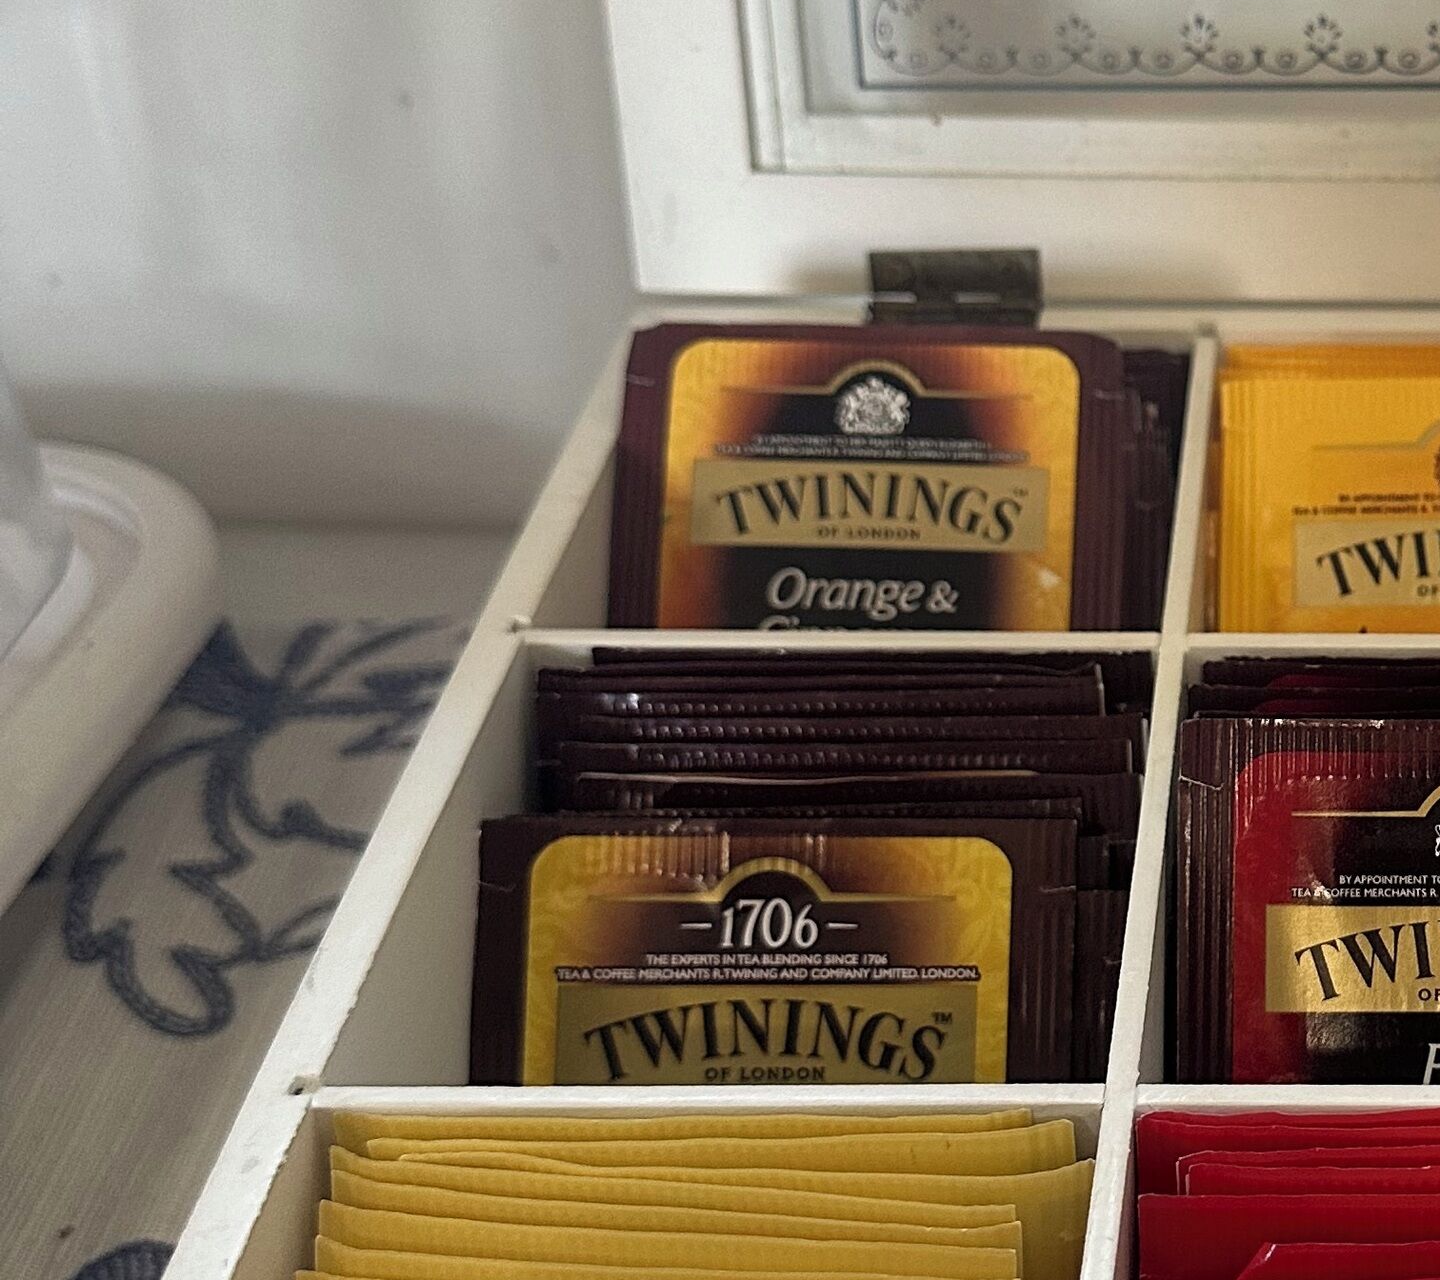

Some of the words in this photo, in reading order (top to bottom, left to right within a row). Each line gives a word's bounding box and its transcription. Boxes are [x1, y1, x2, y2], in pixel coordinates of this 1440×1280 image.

[717, 470, 1023, 545] TWININGS
[817, 527, 838, 539] OF
[848, 527, 921, 540] LONDON
[767, 566, 925, 621] Orange
[926, 580, 959, 613] &
[1417, 584, 1440, 597] OF
[1339, 875, 1352, 884] BY
[1354, 875, 1427, 884] APPOINTMENT
[1292, 888, 1311, 897] TEA
[1326, 888, 1361, 897] COFFEE
[1364, 888, 1427, 897] MERCHANTS
[720, 897, 819, 949] 1706
[647, 954, 669, 965] THE
[671, 954, 720, 966] EXPERTS
[723, 954, 736, 965] IN
[738, 954, 760, 965] TEA
[762, 954, 821, 965] BLENDING
[824, 954, 859, 965] SINCE
[863, 954, 888, 965] 1706
[557, 969, 581, 980] TEA
[593, 969, 636, 980] COFFEE
[638, 969, 711, 980] MERCHANTS
[780, 969, 807, 980] AND
[811, 969, 870, 980] COMPANY
[583, 998, 947, 1082] TWININGS
[705, 1067, 732, 1081] OF
[739, 1067, 825, 1082] LONDON
